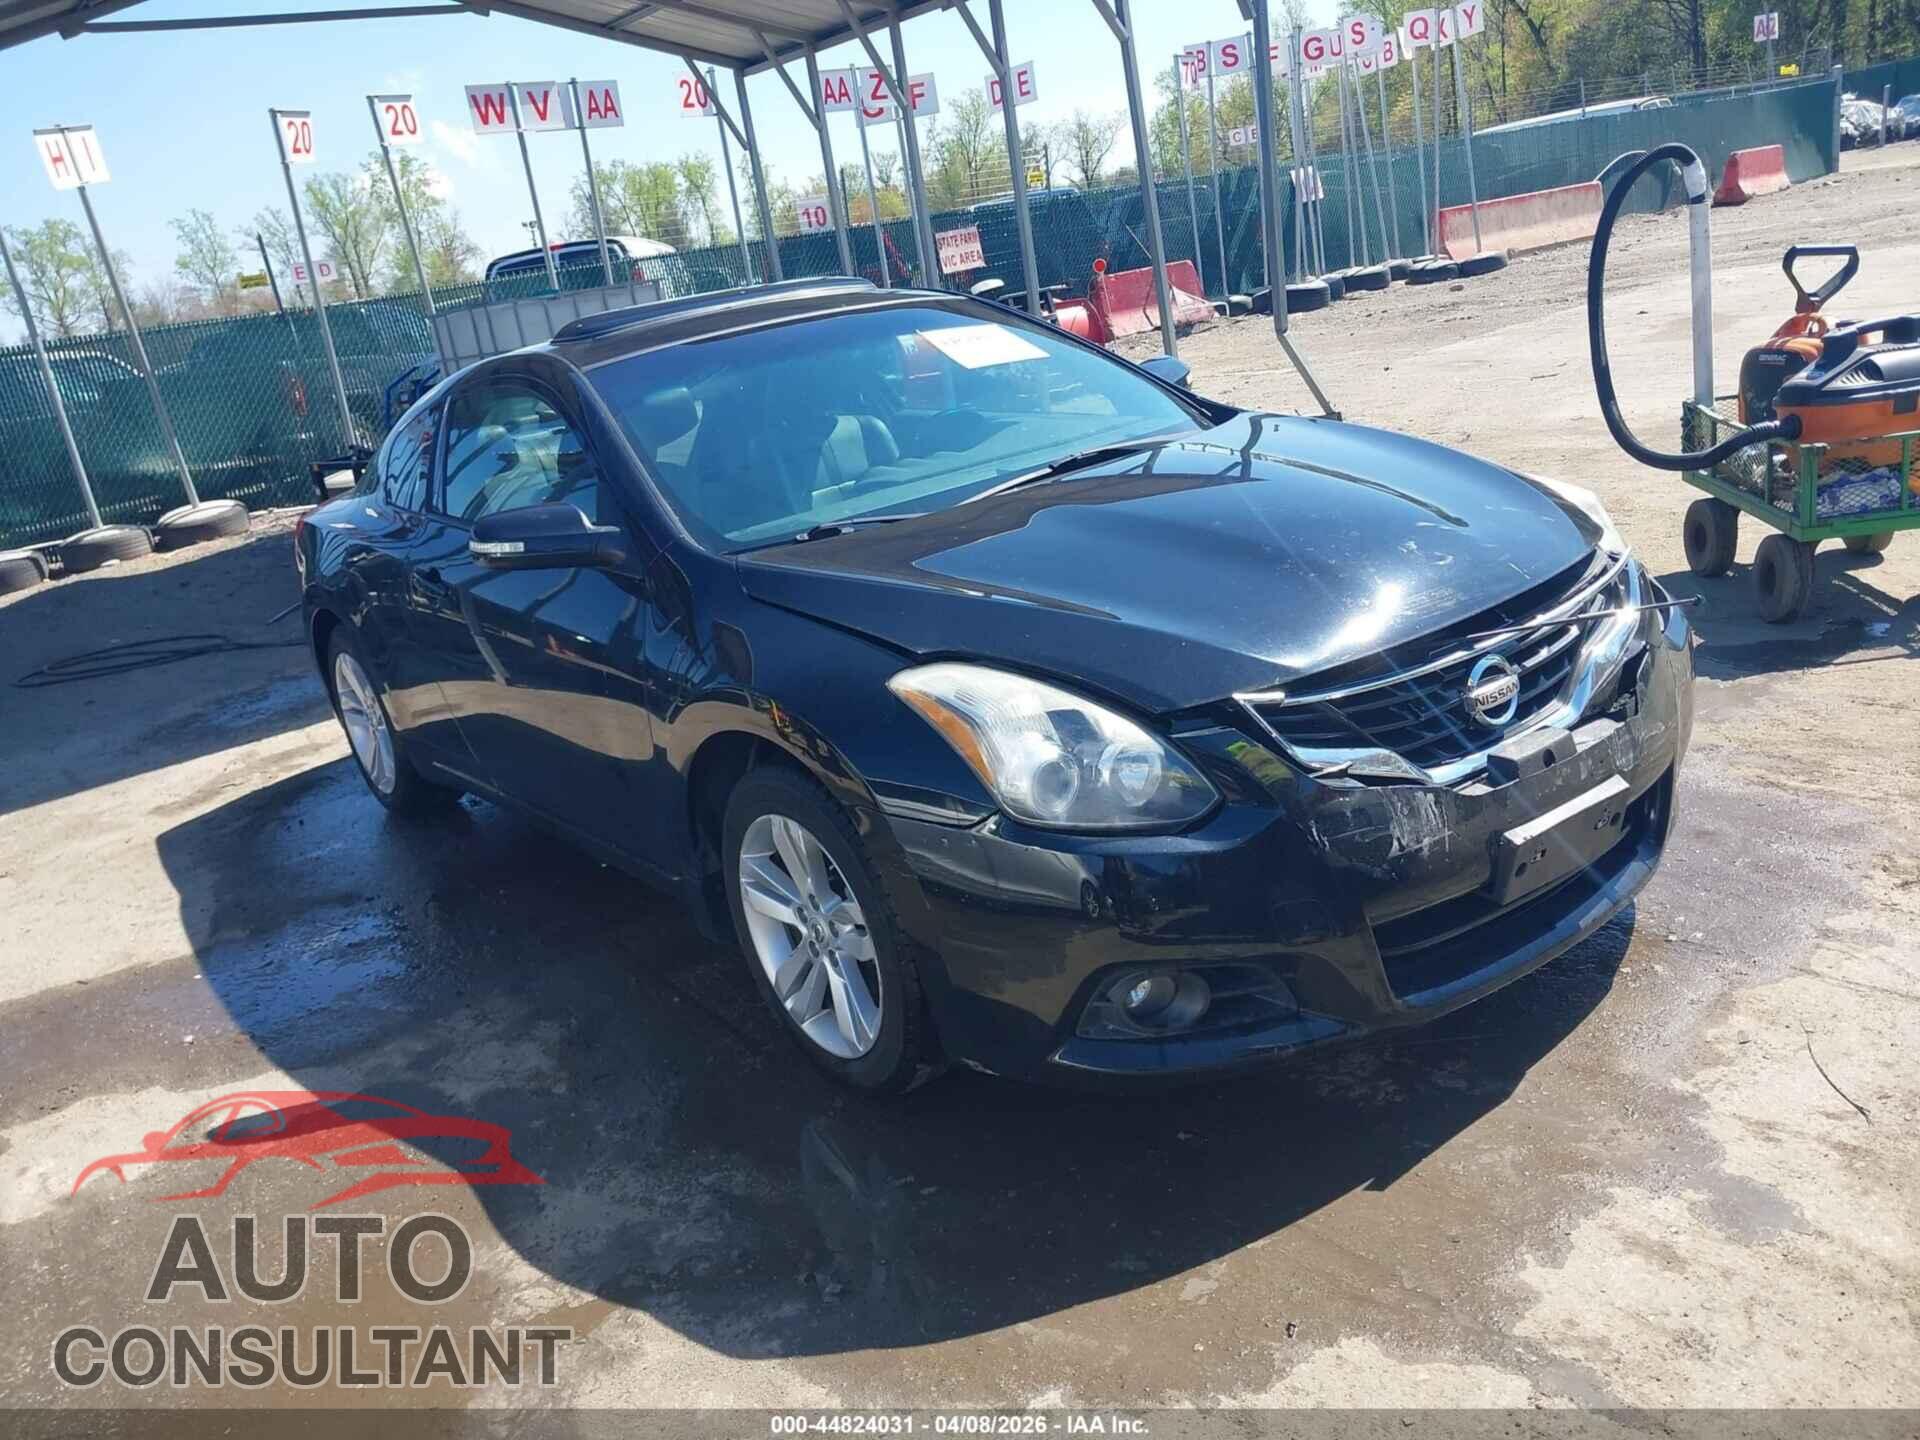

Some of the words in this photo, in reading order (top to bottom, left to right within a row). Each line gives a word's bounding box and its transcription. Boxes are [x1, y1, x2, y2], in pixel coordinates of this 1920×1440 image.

[1410, 17, 1429, 40] Q
[1463, 4, 1476, 28] Y
[1351, 21, 1365, 45] S
[1221, 44, 1239, 67] S
[1303, 36, 1325, 60] G
[679, 79, 709, 109] 20
[824, 77, 852, 104] AA
[869, 74, 889, 100] Z
[908, 82, 925, 110] F
[1017, 71, 1031, 97] E
[471, 92, 505, 126] W
[527, 90, 550, 121] V
[587, 89, 620, 120] AA
[385, 104, 417, 135] 20
[287, 120, 312, 154] 20
[45, 139, 71, 178] H
[802, 206, 827, 228] 10
[937, 235, 959, 250] STATE
[942, 254, 958, 268] VIC
[960, 249, 982, 265] AREA
[294, 266, 306, 280] E
[1475, 682, 1518, 707] NISSAN
